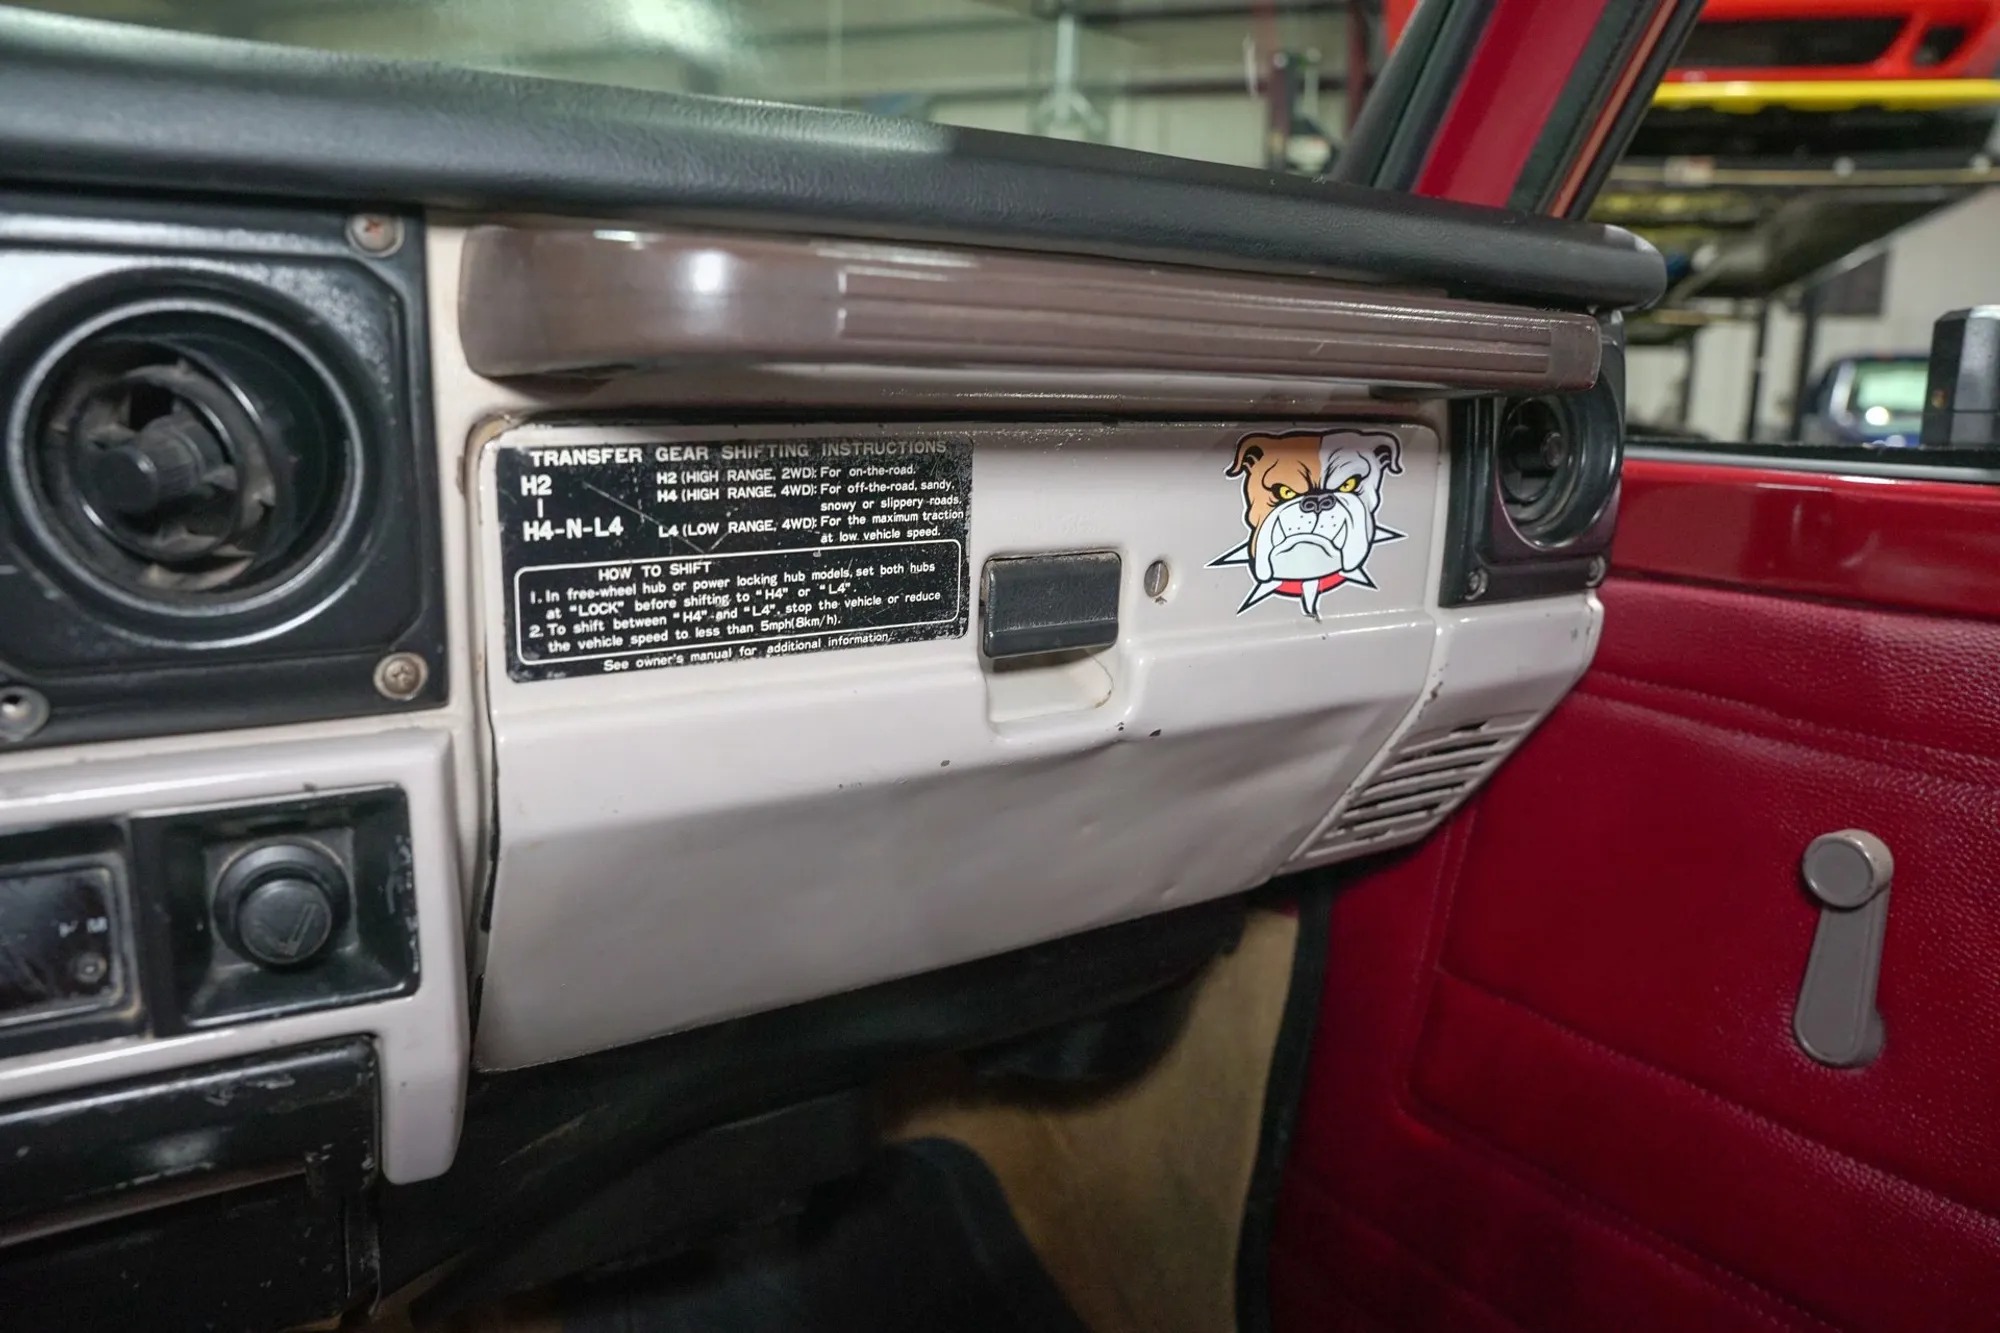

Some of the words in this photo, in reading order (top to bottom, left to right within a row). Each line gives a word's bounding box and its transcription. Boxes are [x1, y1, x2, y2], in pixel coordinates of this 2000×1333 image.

[529, 448, 642, 466] TRANSFER
[655, 446, 708, 461] GEAR
[722, 444, 809, 459] SHIFTING
[822, 442, 946, 456] INSTRUCTIONS
[521, 474, 552, 496] H2
[657, 472, 677, 484] H2
[681, 470, 718, 484] (HIGH
[727, 469, 776, 481] RANGE,
[781, 467, 817, 480] 2WD):
[820, 466, 841, 478] For
[849, 464, 916, 476] on-the-road.
[657, 489, 678, 502] H4
[681, 488, 719, 502] (HIGH
[727, 486, 776, 499] RANGE,
[781, 484, 817, 496] 4WD):
[820, 483, 841, 495] For
[820, 501, 856, 511] snowy
[862, 500, 874, 509] or
[881, 497, 923, 510] slippery
[523, 516, 624, 542] H4-N-L4
[659, 525, 679, 538] L4
[682, 522, 719, 536] (LOW
[728, 520, 776, 533] RANGE,
[781, 517, 817, 529] 4WD):
[821, 516, 841, 527] For
[848, 514, 866, 525] the
[872, 512, 918, 523] maximum
[922, 509, 963, 521] traction
[820, 533, 833, 543] at
[840, 532, 857, 542] low
[864, 528, 901, 540] vehicle
[907, 526, 940, 539] speed.
[530, 591, 542, 604] 1.
[546, 590, 560, 603] In
[567, 584, 636, 602] free-wheel
[643, 581, 666, 593] hub
[673, 581, 686, 591] or
[693, 578, 730, 592] power
[737, 573, 778, 587] locking
[784, 570, 805, 583] hub
[856, 566, 874, 577] set
[880, 563, 904, 575] both
[910, 562, 935, 573] hubs
[598, 567, 632, 582] HOW
[641, 565, 662, 578] TO
[670, 562, 712, 576] SHIFT
[529, 625, 544, 638] 2.
[547, 623, 566, 636] To
[573, 619, 605, 634] shift
[613, 615, 667, 630] between
[716, 608, 738, 622] and
[785, 601, 812, 615] stop
[818, 599, 838, 610] the
[844, 595, 881, 608] vehicle
[888, 594, 899, 604] or
[905, 591, 941, 602] reduce
[546, 608, 562, 620] at
[635, 597, 676, 612] before
[683, 593, 730, 608] shifting
[736, 591, 750, 602] to
[798, 587, 810, 597] or
[548, 639, 570, 653] the
[577, 635, 623, 651] vehicle
[630, 630, 668, 645] speed
[675, 628, 688, 639] to
[695, 626, 720, 638] less
[727, 623, 753, 635] than
[604, 660, 628, 672] See
[636, 653, 683, 668] owner's
[690, 648, 732, 662] manual
[739, 646, 757, 657] for
[767, 640, 821, 654] additional
